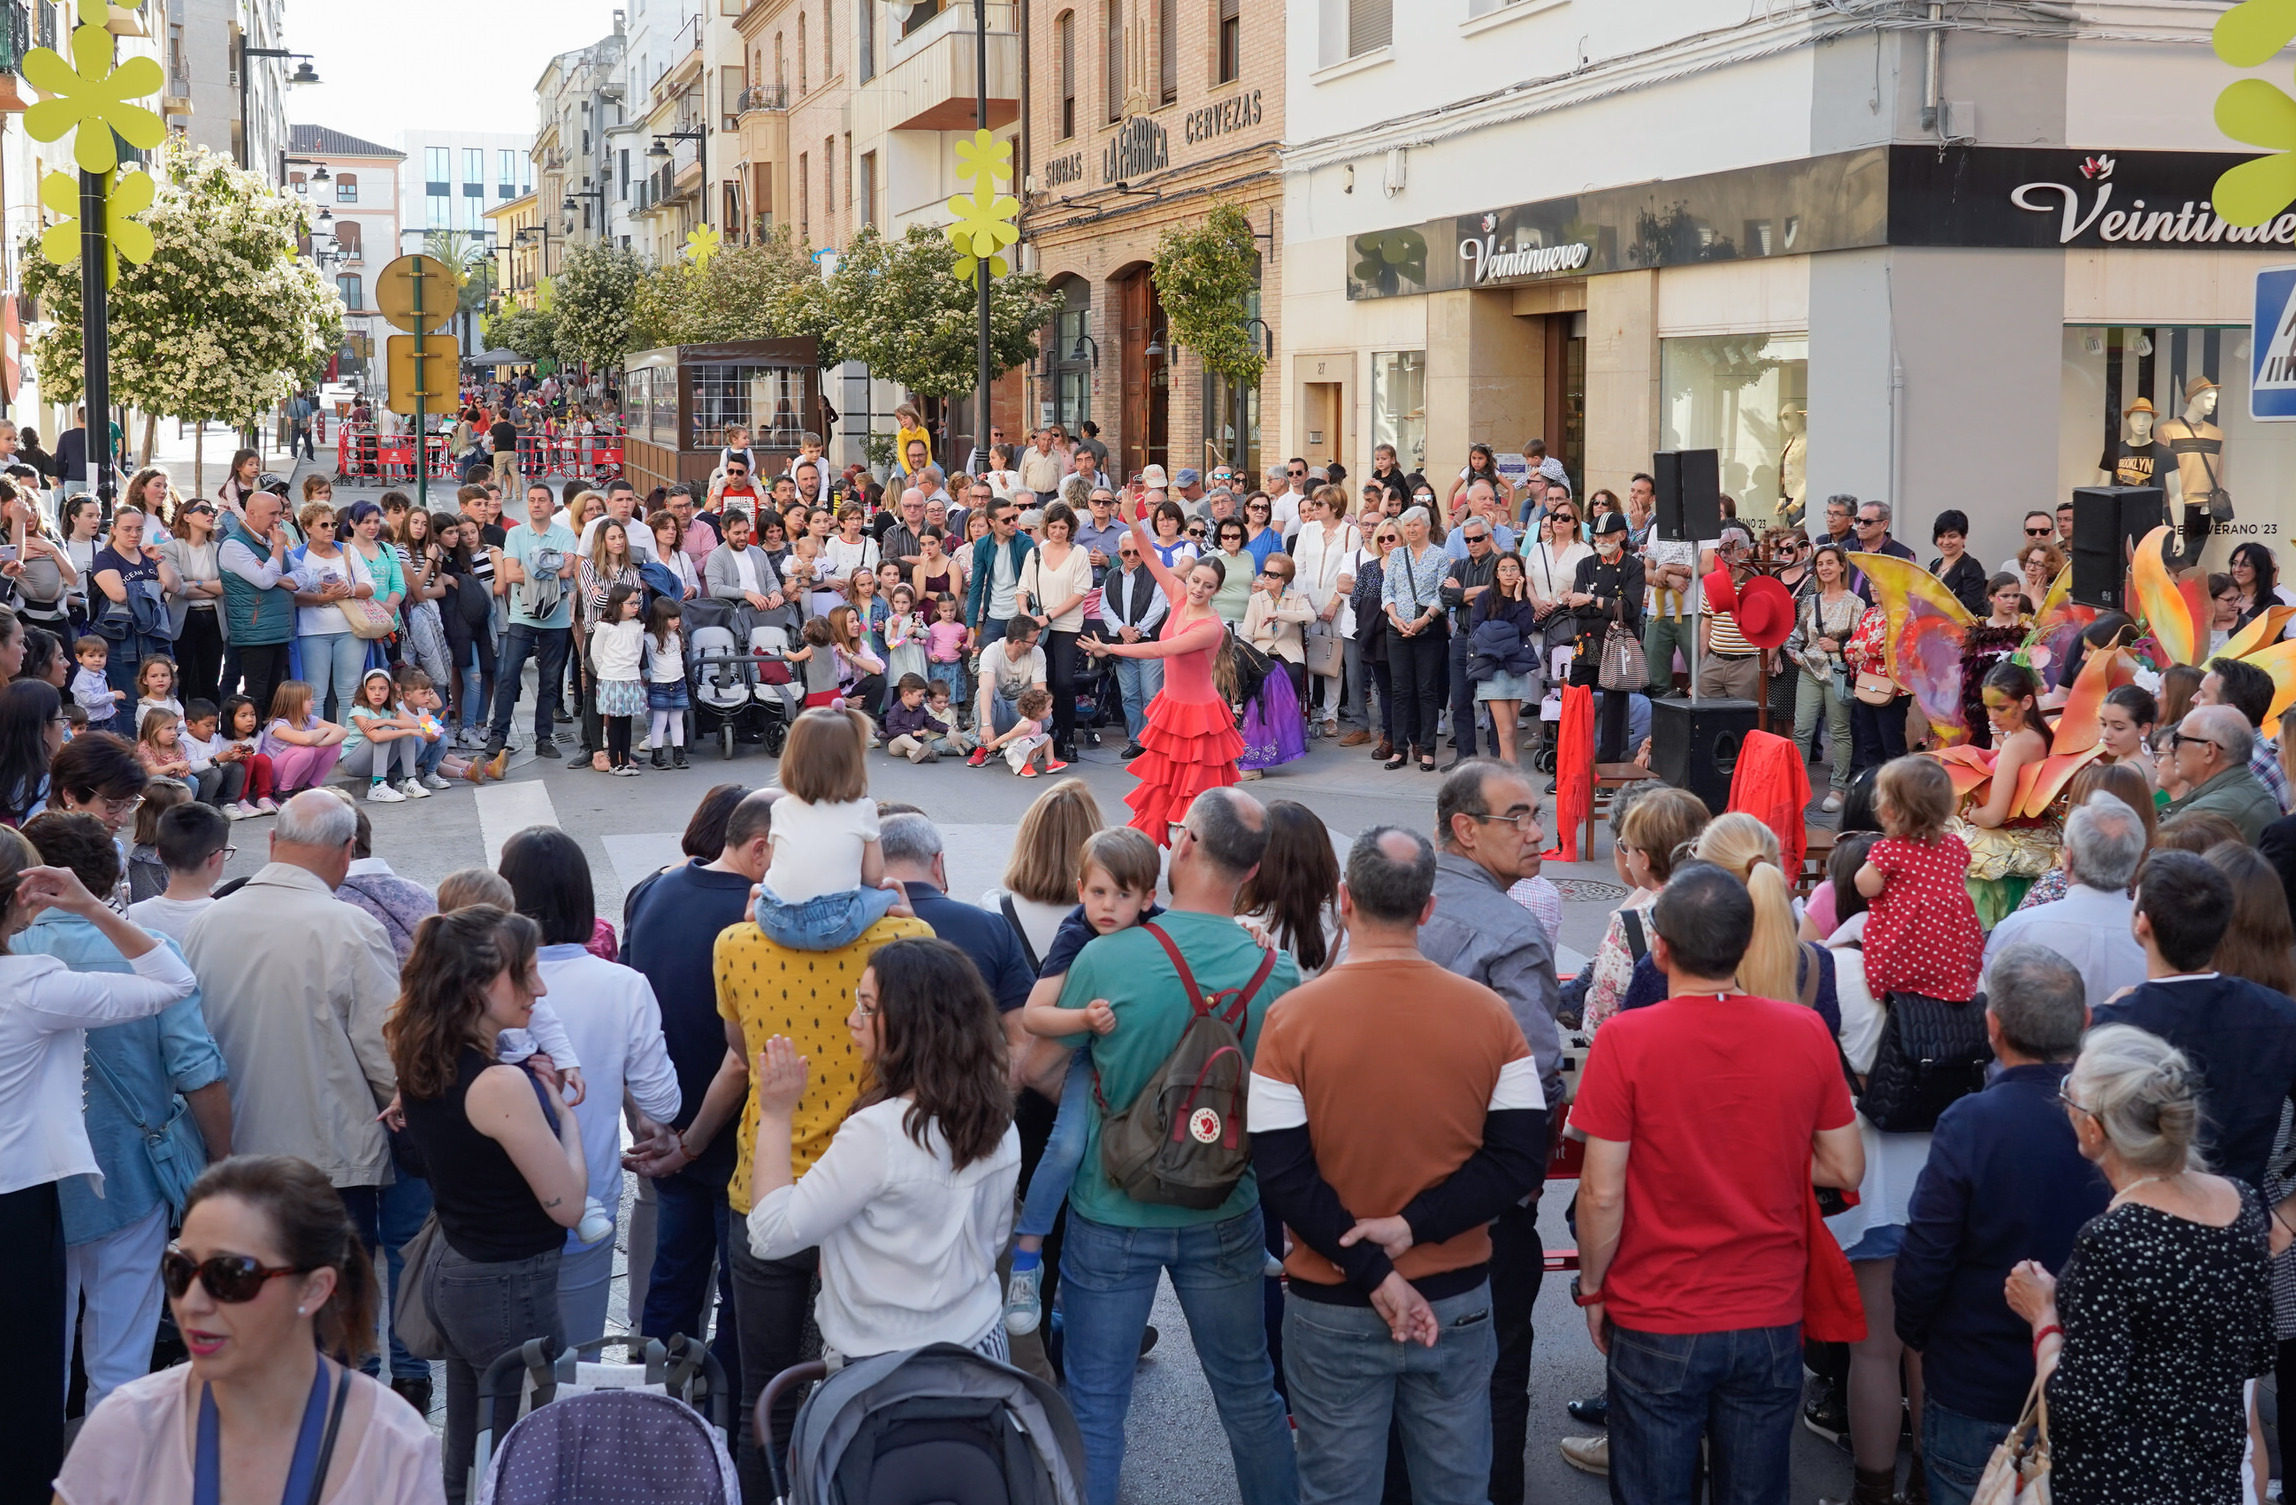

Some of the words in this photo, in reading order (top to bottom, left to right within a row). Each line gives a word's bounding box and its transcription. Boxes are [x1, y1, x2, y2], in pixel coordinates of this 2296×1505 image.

[1185, 89, 1262, 145] CERVEZAS
[1045, 151, 1082, 188] SIDRAS
[1102, 137, 1118, 184] LA
[1118, 115, 1169, 179] FÁBRICA
[1459, 234, 1591, 284] Veintinueve
[2118, 457, 2155, 474] BROOKLYN
[2207, 524, 2258, 535] VERANO
[2261, 524, 2277, 534] '23
